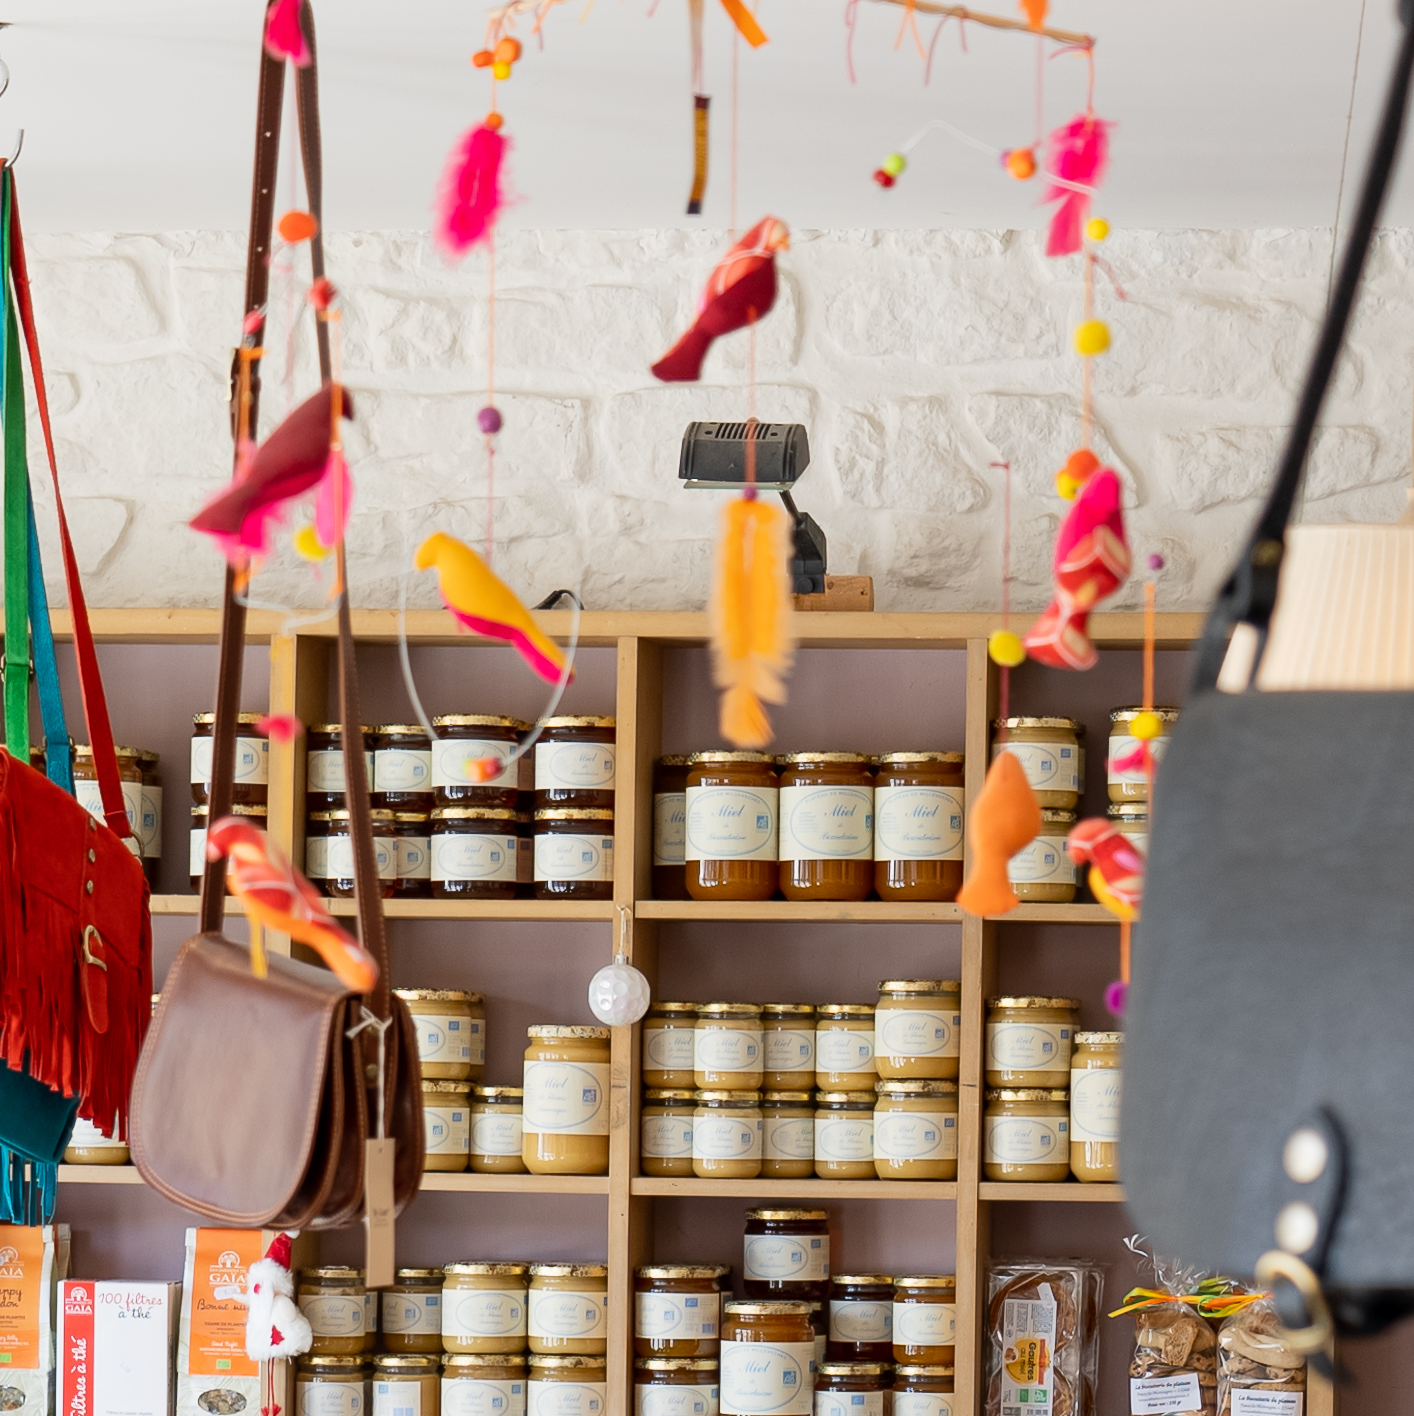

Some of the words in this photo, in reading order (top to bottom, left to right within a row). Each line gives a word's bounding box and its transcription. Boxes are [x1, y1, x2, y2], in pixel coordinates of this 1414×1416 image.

[711, 804, 745, 818] Miel
[824, 804, 857, 817] Miel
[905, 803, 937, 817] Miel
[209, 1272, 246, 1283] GAÏA
[98, 1293, 123, 1304] 100
[125, 1293, 163, 1312] filtres
[70, 1335, 87, 1361] thé
[71, 1363, 87, 1374] à
[740, 1360, 771, 1373] Miel
[1027, 1342, 1037, 1381] Gaufres
